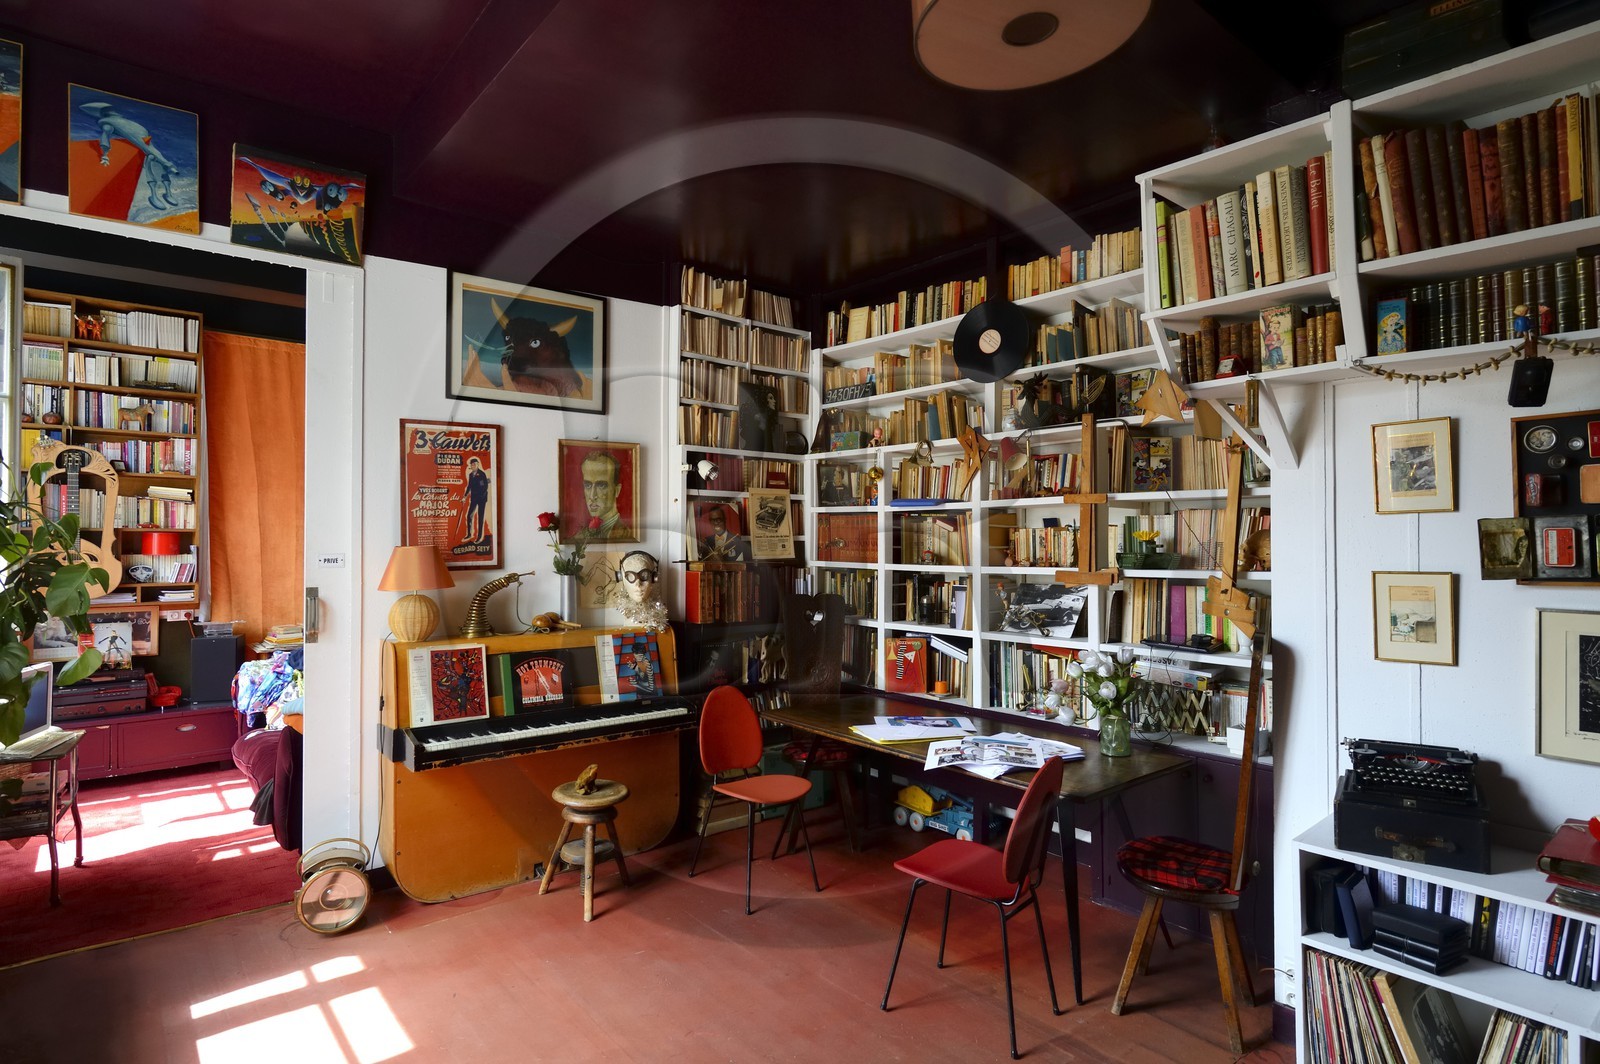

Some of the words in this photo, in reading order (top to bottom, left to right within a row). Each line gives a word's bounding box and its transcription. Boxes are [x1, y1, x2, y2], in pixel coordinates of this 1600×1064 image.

[1310, 162, 1320, 175] Le
[1280, 181, 1288, 220] INVENTEURS
[1310, 179, 1322, 209] Ballet
[1224, 197, 1237, 245] CHAGALL
[1229, 247, 1240, 278] MARC
[415, 430, 429, 449] 3
[411, 508, 457, 517] THOMPSON
[420, 501, 449, 509] MAJOR
[516, 664, 530, 676] HOT
[530, 660, 564, 673] TRUMPETS
[522, 696, 544, 704] COLUMBIA
[545, 693, 564, 702] RECORDS
